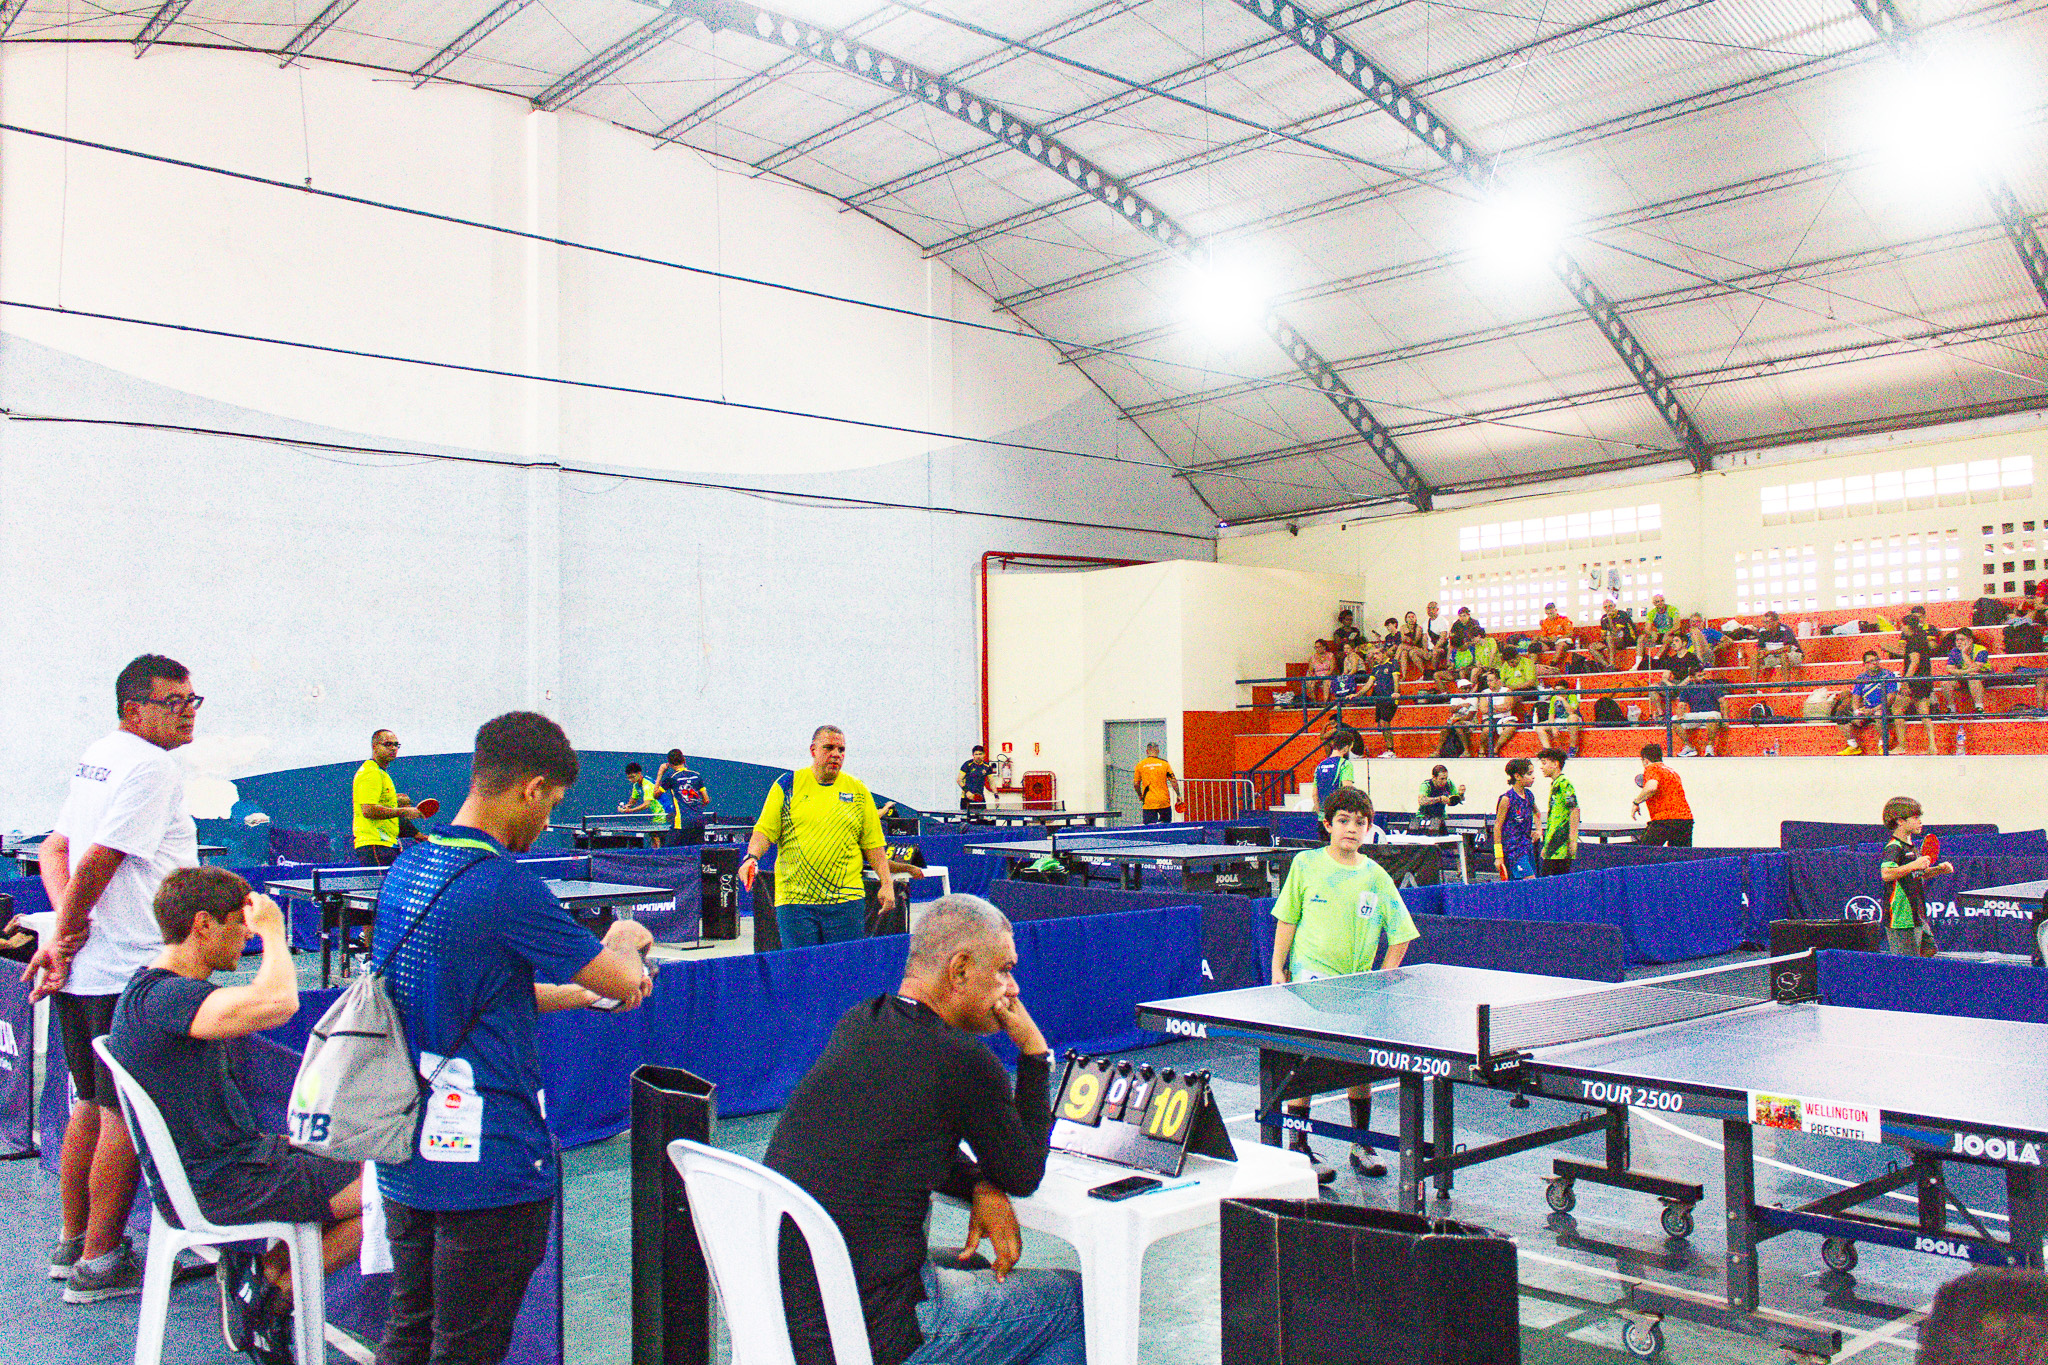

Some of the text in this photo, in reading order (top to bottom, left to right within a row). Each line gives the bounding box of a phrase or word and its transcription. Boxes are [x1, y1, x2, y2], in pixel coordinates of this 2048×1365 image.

[1215, 873, 1239, 884] JOOLA
[1983, 899, 2020, 911] JOOLA
[1165, 1017, 1208, 1039] JOOLA
[1368, 1048, 1451, 1077] TOUR 2500
[1498, 1060, 1520, 1071] JOOLA
[1063, 1073, 1100, 1119] 9
[1108, 1077, 1127, 1104] 0
[1148, 1087, 1189, 1138] 10
[1581, 1080, 1683, 1112] TOUR 2500
[1804, 1102, 1869, 1123] WELLINGTON
[1282, 1117, 1313, 1133] JOOLA
[1952, 1132, 2041, 1166] JOOLA
[1914, 1236, 1970, 1259] JOOLA
